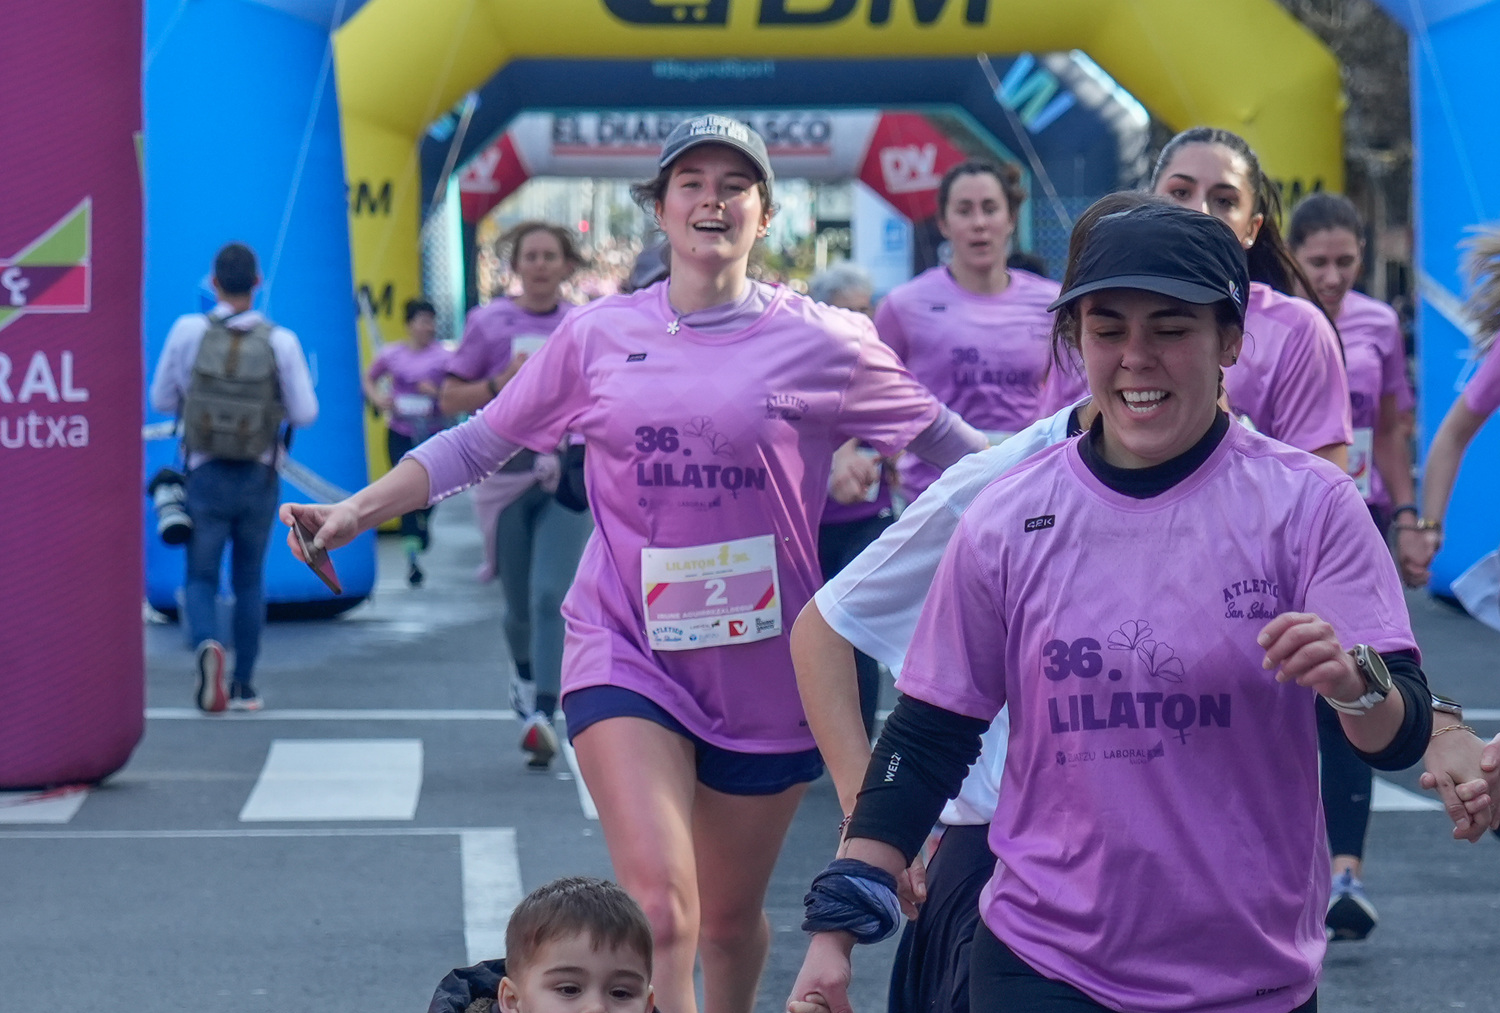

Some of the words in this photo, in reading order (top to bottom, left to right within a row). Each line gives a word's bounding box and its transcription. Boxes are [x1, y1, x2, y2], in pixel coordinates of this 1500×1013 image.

[0, 409, 90, 449] utxa
[635, 426, 692, 457] 36.
[637, 463, 767, 493] LILATON
[703, 579, 729, 607] 2
[1222, 579, 1278, 603] ATLETIC
[1225, 601, 1244, 619] San
[1042, 637, 1122, 681] 36.
[1048, 692, 1231, 738] LILATON
[1103, 748, 1146, 760] LABORAL
